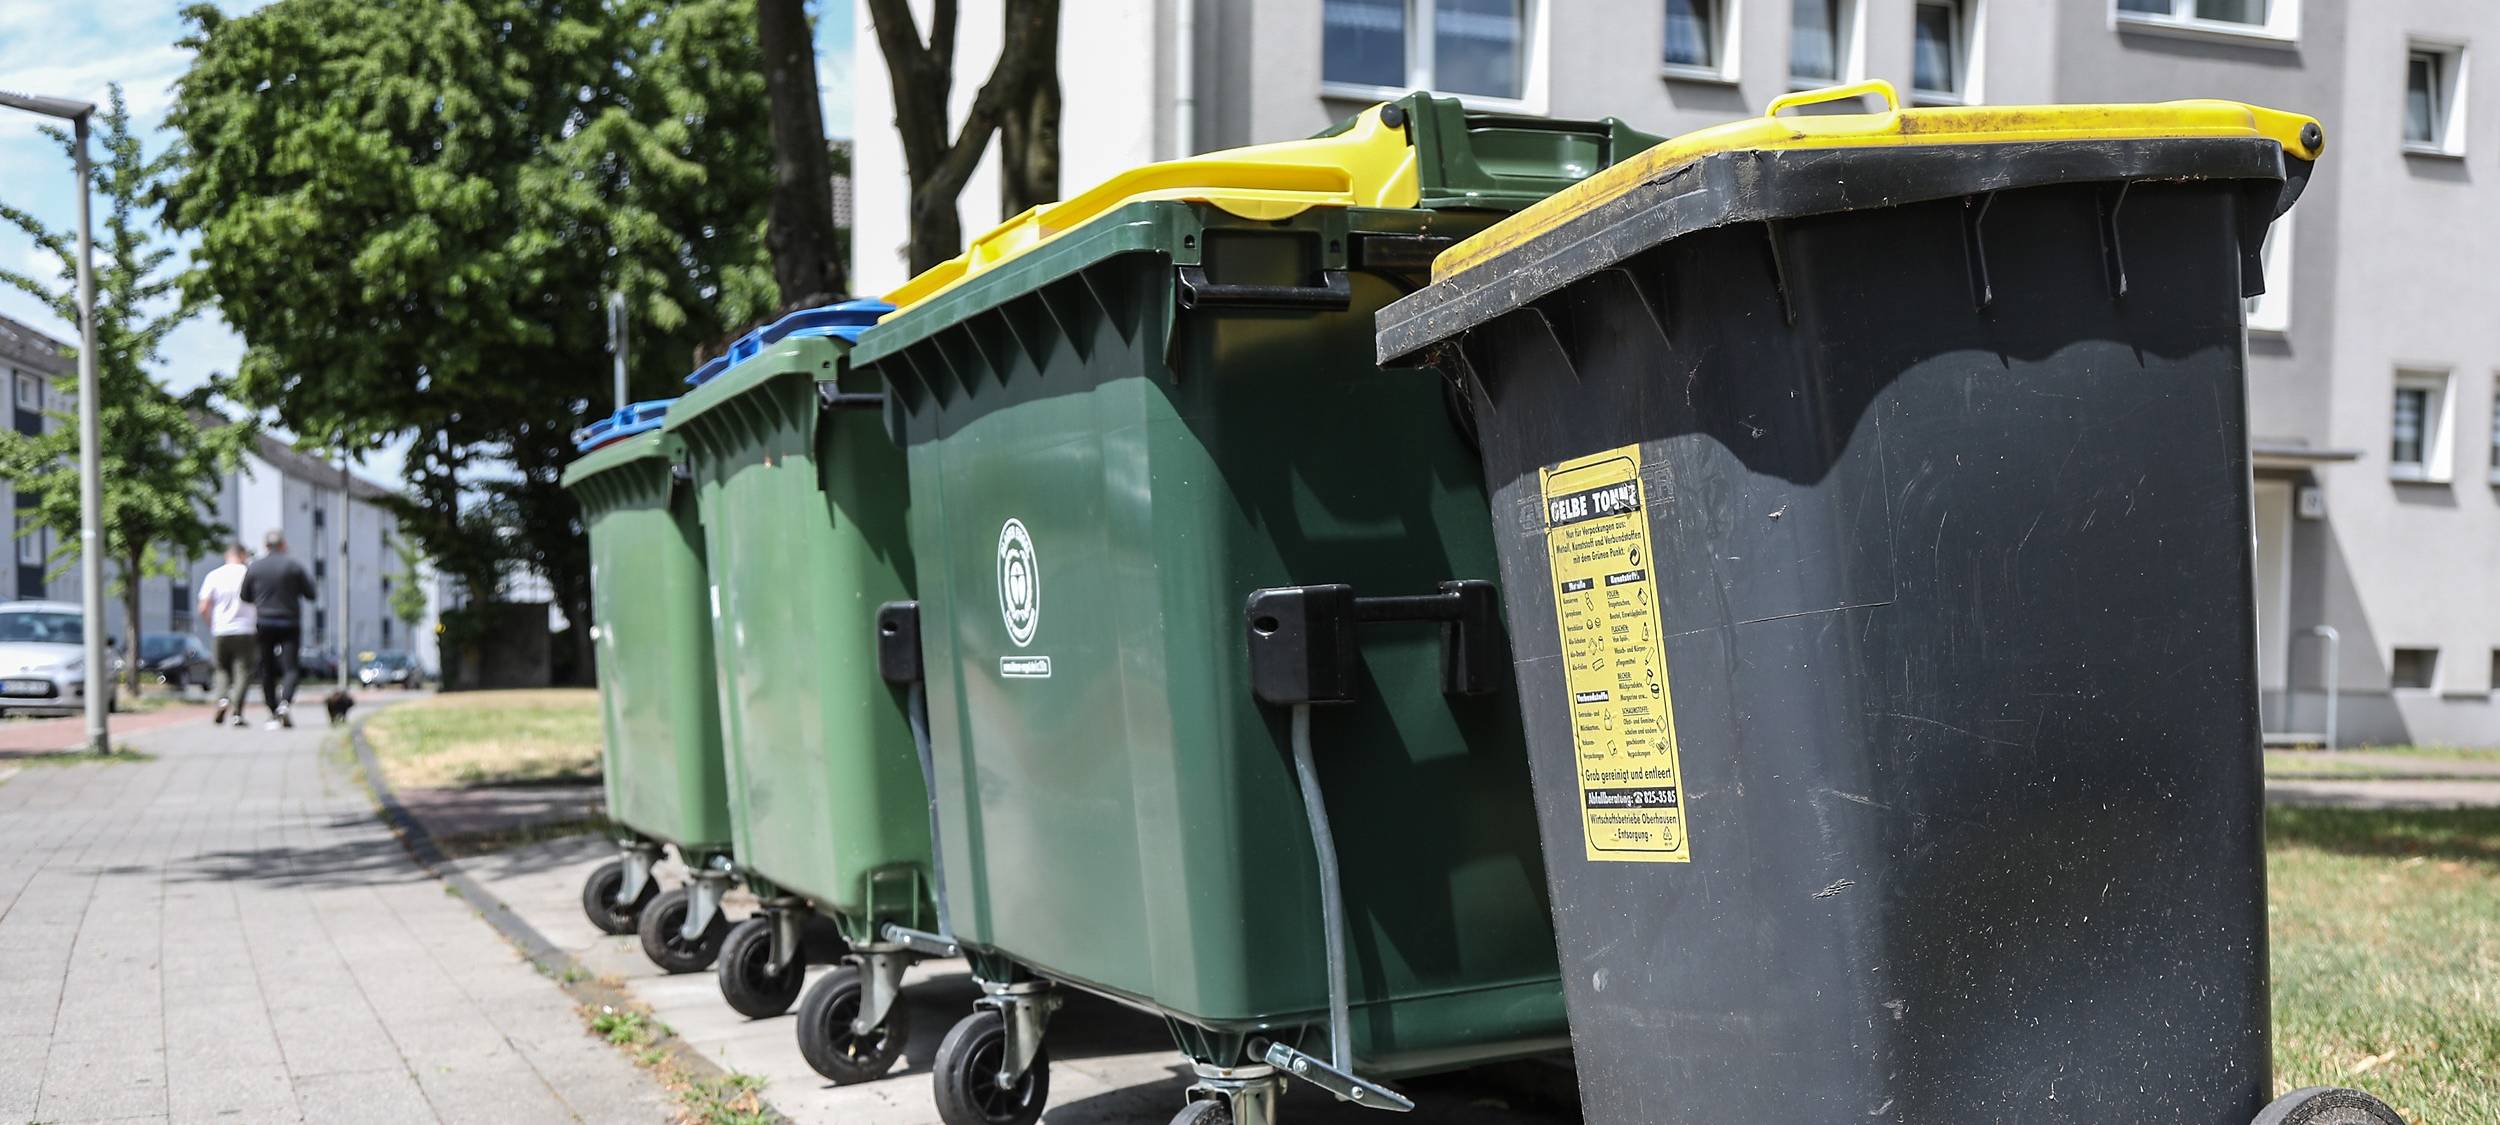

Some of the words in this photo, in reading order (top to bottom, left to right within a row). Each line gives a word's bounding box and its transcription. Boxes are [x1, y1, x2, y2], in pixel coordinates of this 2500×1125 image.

[1550, 495, 1588, 523] GELBE
[1574, 528, 1582, 537] für
[1582, 521, 1615, 538] Verpackungen
[1616, 521, 1626, 529] aus:
[1556, 543, 1571, 555] Metall,
[1572, 539, 1594, 551] Kunststoff
[1595, 537, 1604, 546] und
[1604, 529, 1641, 545] Verbundstoffen
[1581, 553, 1591, 563] dem
[1591, 549, 1609, 561] Grünen
[1610, 546, 1625, 557] Punkt.
[1585, 769, 1600, 782] Grob
[1601, 768, 1630, 784] gereinigt
[1630, 767, 1643, 780] und
[1644, 766, 1671, 779] entleert
[1587, 791, 1634, 807] Abfallberatung:
[1590, 813, 1641, 824] Wirtschaftsbetriebe
[1641, 812, 1677, 824] Oberhausen
[1617, 828, 1649, 841] Entsorgung
